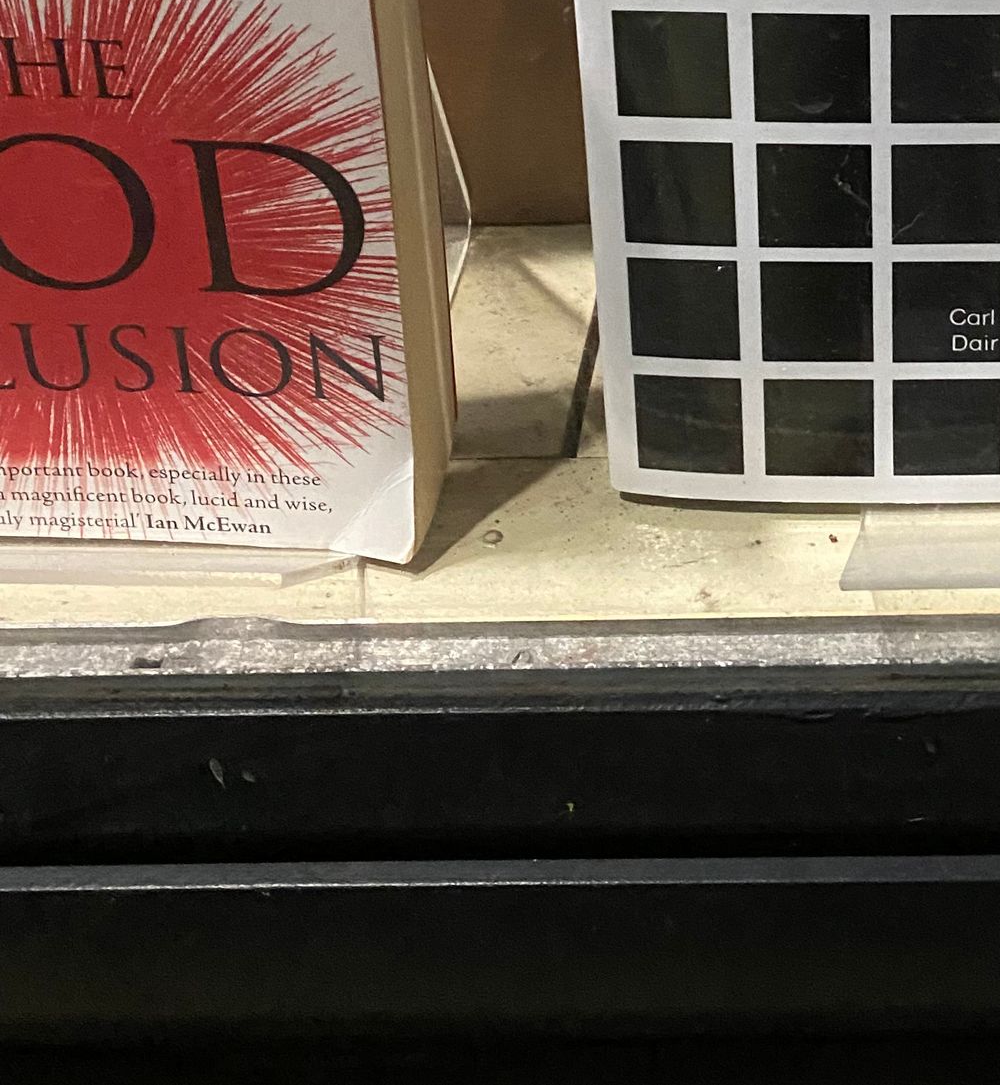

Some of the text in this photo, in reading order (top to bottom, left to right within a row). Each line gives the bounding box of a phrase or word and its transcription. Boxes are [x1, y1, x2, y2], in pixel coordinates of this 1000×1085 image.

[948, 307, 996, 327] Carl
[951, 334, 1000, 352] Dair
[0, 321, 387, 404] USION
[87, 461, 145, 480] book,
[149, 465, 241, 487] especially
[247, 468, 266, 485] in
[271, 468, 322, 487] these
[11, 485, 129, 507] magnificent
[131, 487, 187, 506] book,
[191, 489, 240, 508] lucid
[244, 493, 281, 511] and
[285, 496, 334, 515] wise,
[145, 513, 179, 531] Ian
[184, 515, 272, 535] McEwan
